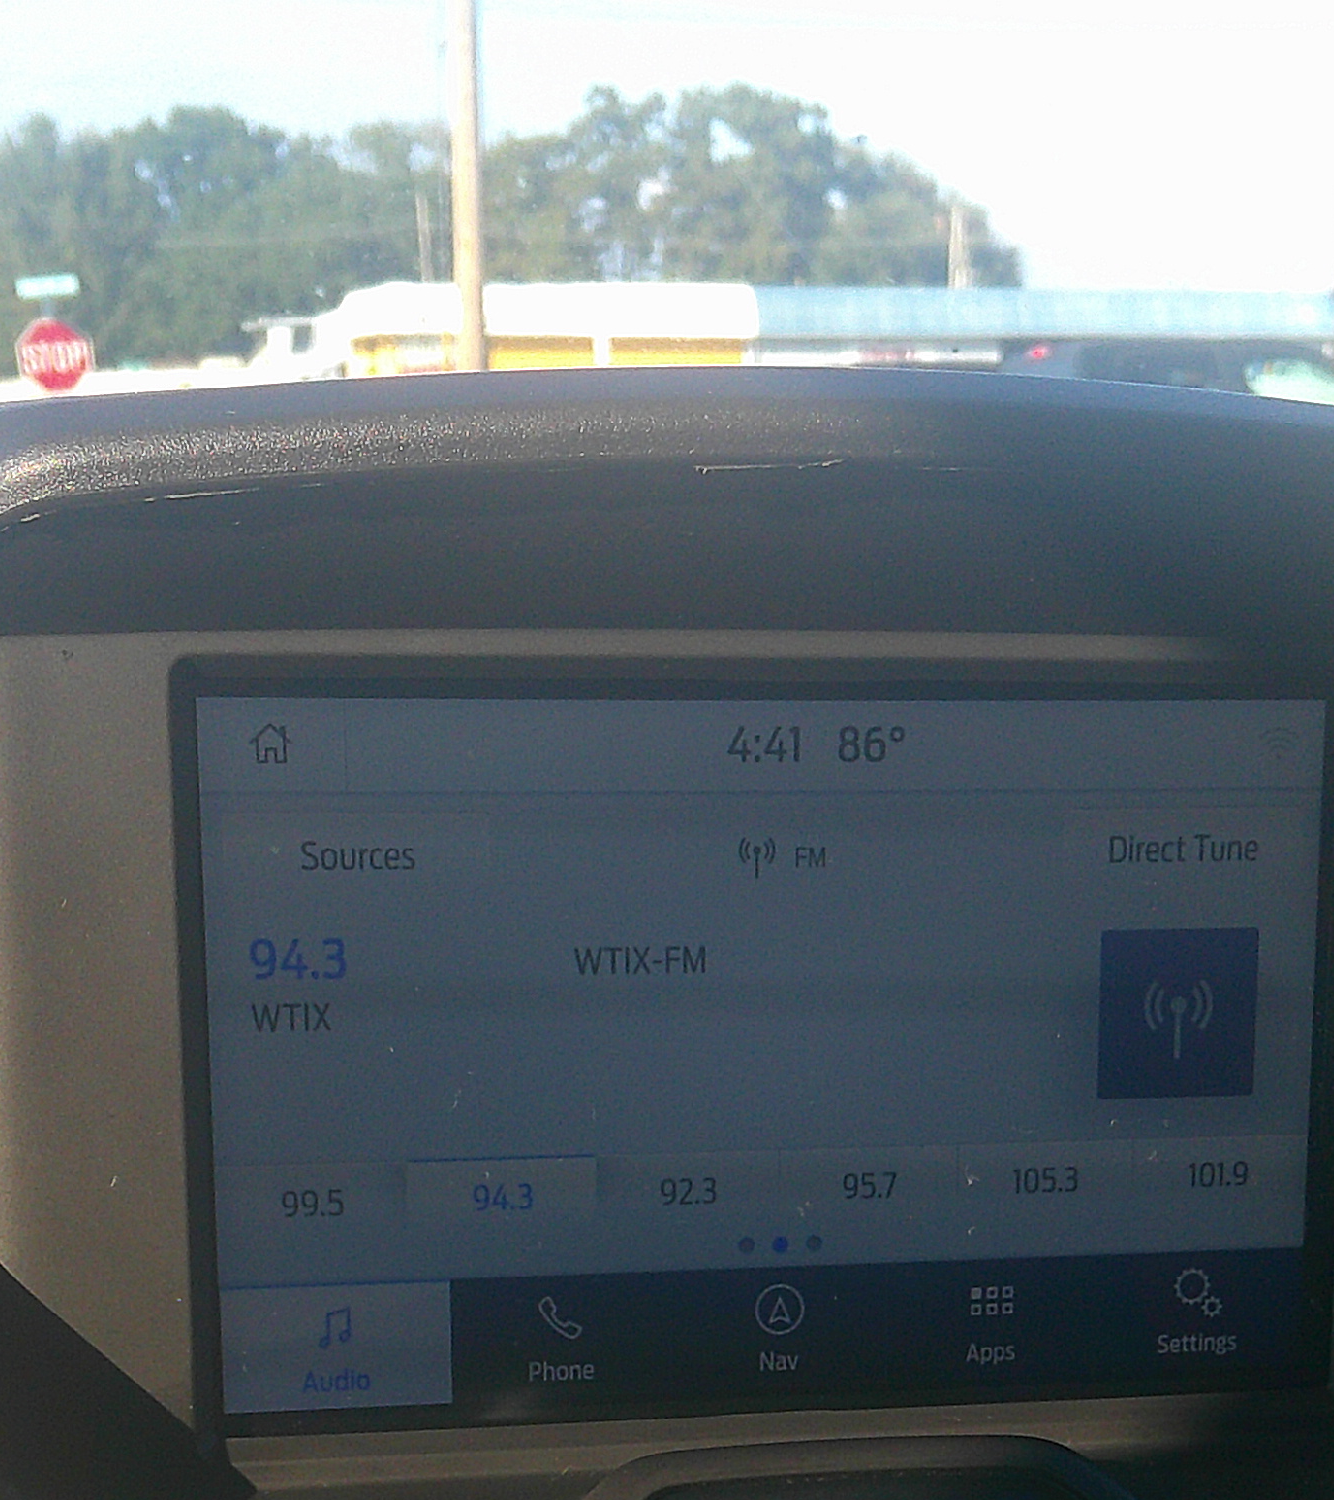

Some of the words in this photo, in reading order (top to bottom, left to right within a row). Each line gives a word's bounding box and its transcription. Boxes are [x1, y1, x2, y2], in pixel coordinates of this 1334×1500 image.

[21, 339, 89, 375] STOP
[725, 725, 802, 765] 4:41
[299, 839, 417, 873] Sources
[793, 844, 828, 870] FM
[1107, 833, 1186, 864] Direct
[1192, 832, 1260, 863] Tune
[248, 936, 349, 982] 94.3
[572, 943, 708, 977] WTIX-FM
[249, 1000, 332, 1034] WTIX
[841, 1169, 899, 1202] 95.7
[1011, 1165, 1081, 1196] 105.3
[1187, 1158, 1251, 1190] 101.9
[279, 1187, 346, 1219] 99.5
[471, 1181, 535, 1213] 94.3
[658, 1175, 719, 1207] 92.3
[964, 1341, 1017, 1367] Apps
[1155, 1327, 1239, 1357] Settings
[527, 1356, 596, 1382] Phone
[758, 1349, 800, 1373] Nav
[300, 1366, 373, 1394] Audio
